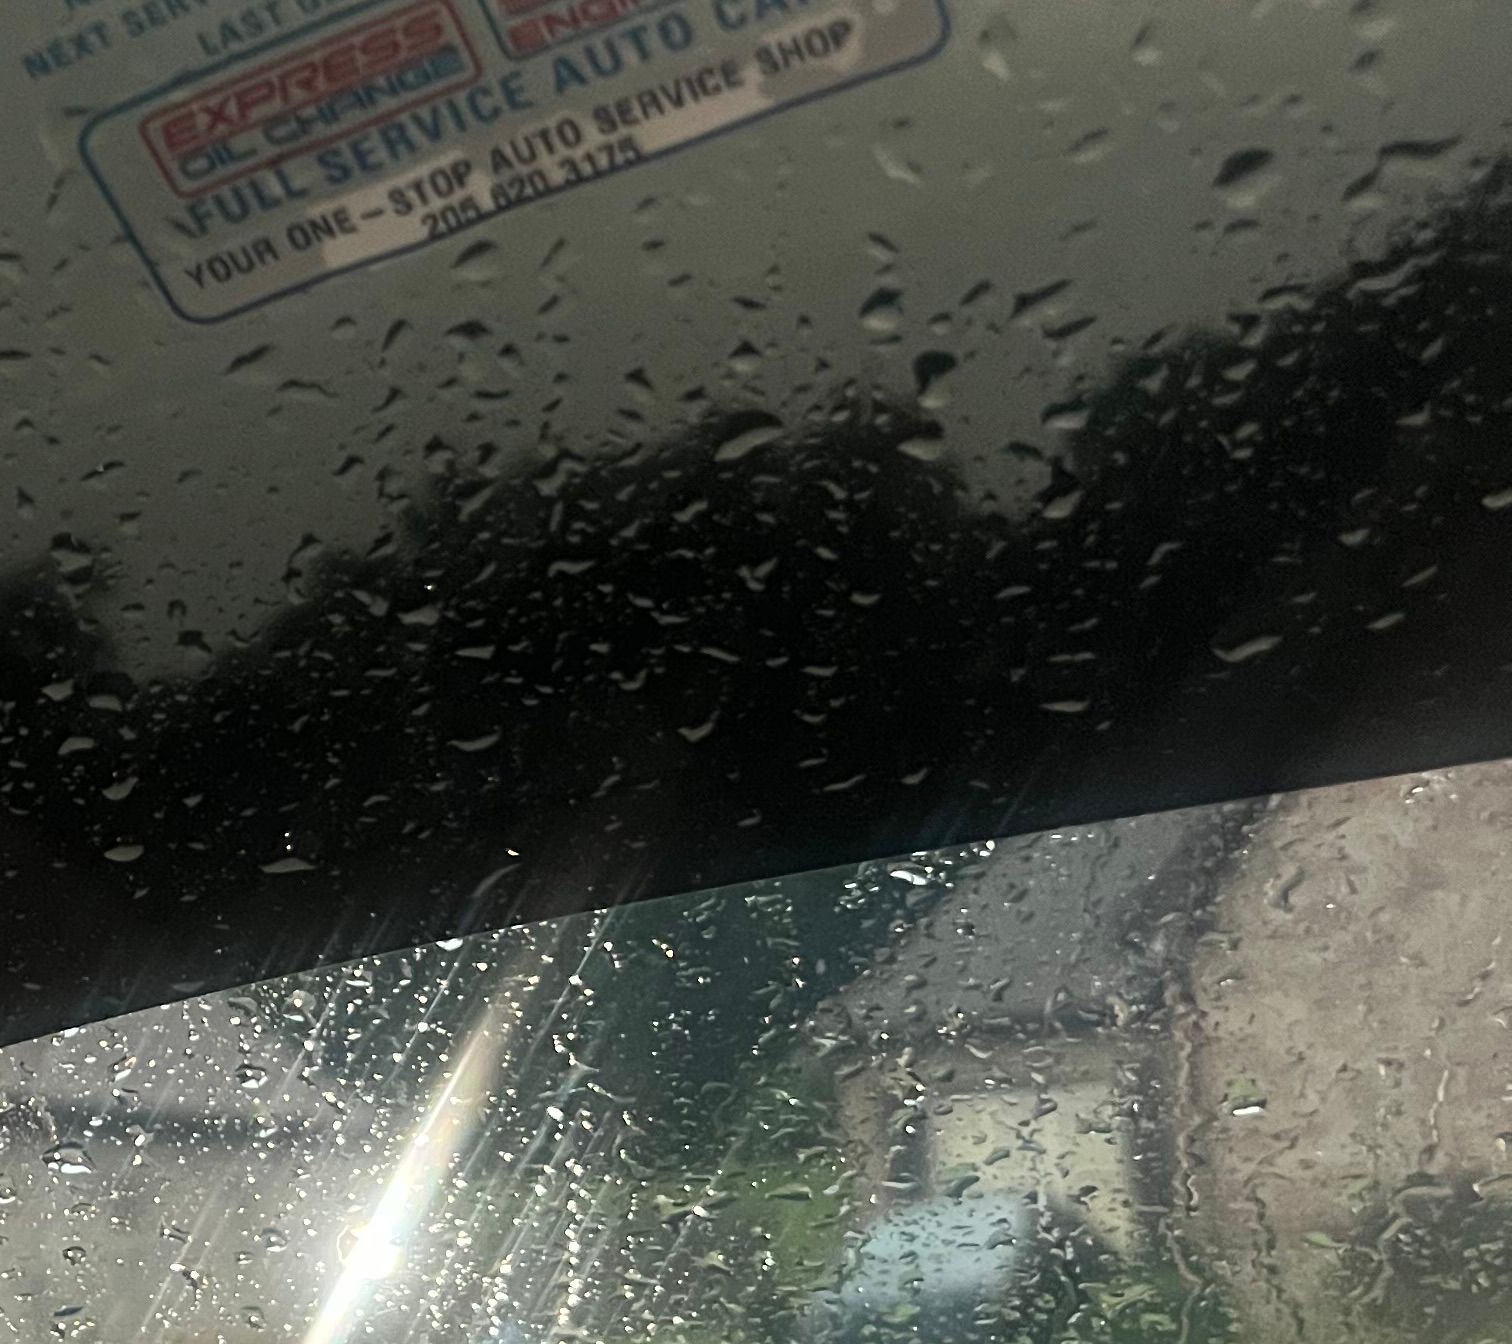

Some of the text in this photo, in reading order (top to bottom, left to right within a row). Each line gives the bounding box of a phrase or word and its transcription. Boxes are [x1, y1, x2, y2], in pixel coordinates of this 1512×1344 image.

[23, 20, 110, 79] NEXT
[163, 8, 445, 152] EXPRESS
[197, 0, 282, 55] LAST
[179, 44, 465, 182] OIL CHANGE
[185, 163, 308, 239] FULL
[317, 71, 534, 186] SERVICE
[552, 10, 694, 96] AUTO
[185, 238, 281, 290] YOUR
[492, 118, 583, 175] AUTO
[593, 62, 747, 135] SERVICE
[756, 18, 852, 77] SHOP
